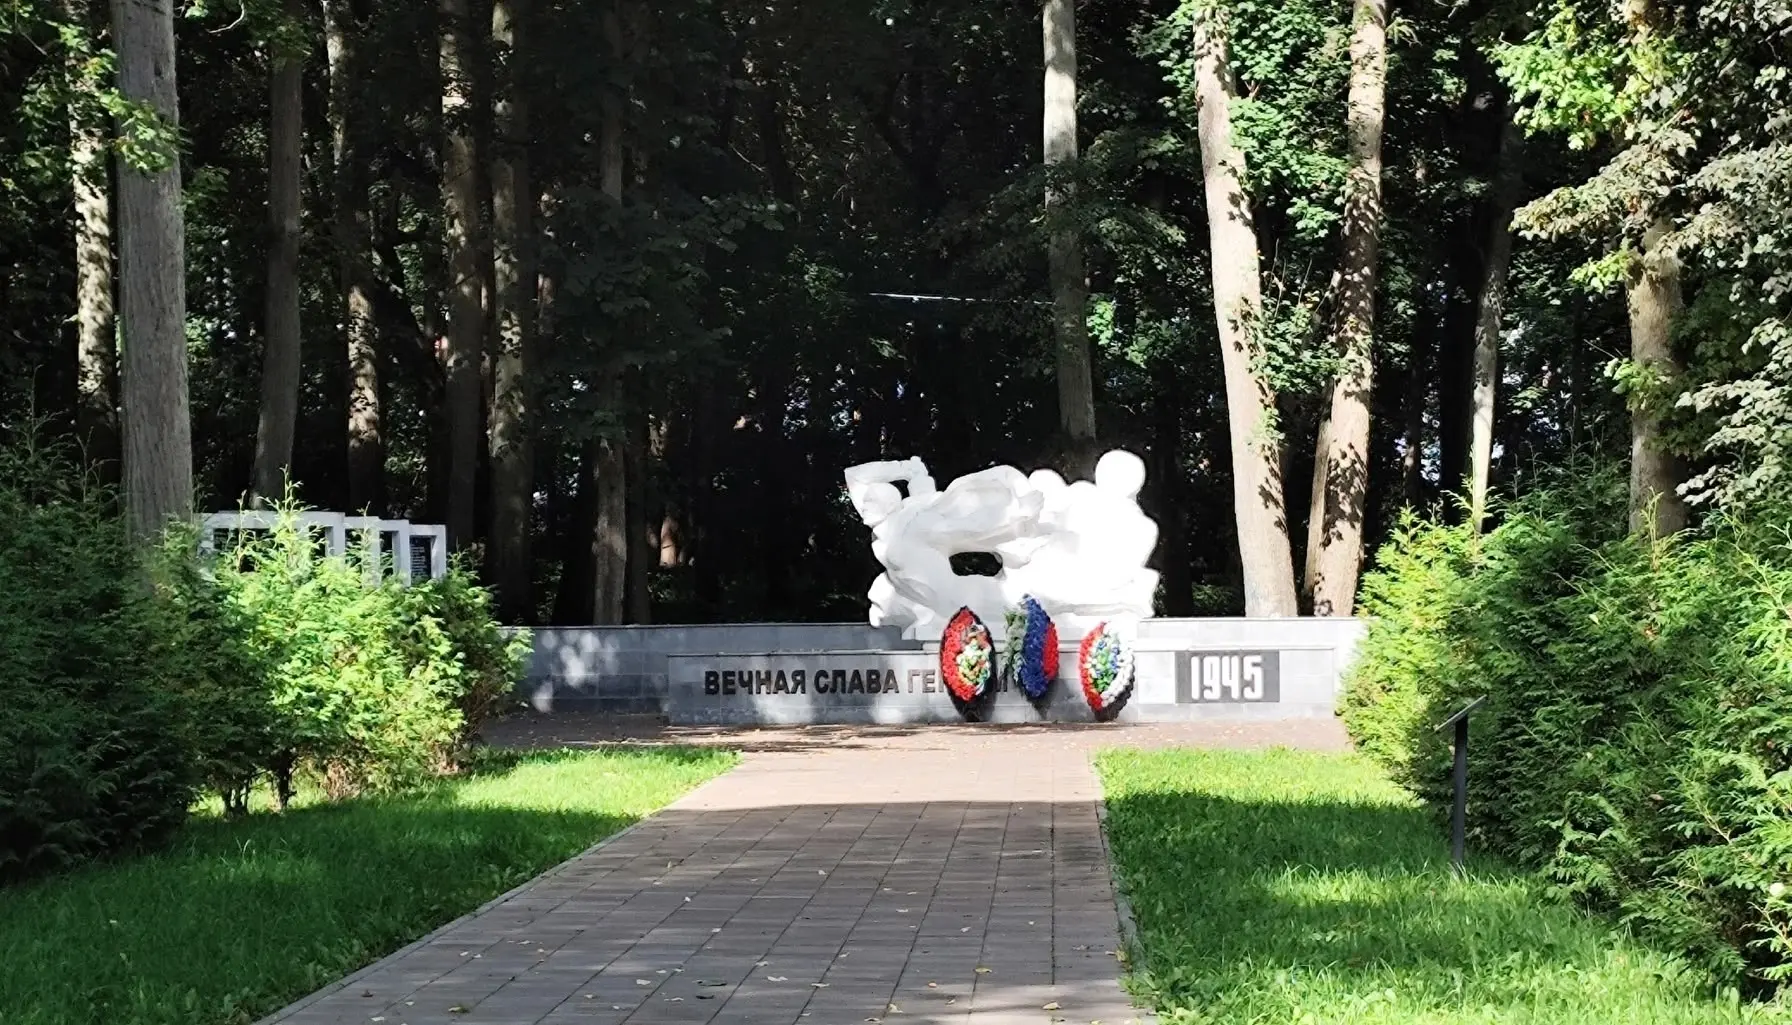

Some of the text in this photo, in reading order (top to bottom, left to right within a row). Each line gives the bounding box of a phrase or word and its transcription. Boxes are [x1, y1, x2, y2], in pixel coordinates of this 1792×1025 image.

[705, 669, 806, 695] ВЕЧНАЯ
[814, 669, 900, 694] СЛАВА
[1190, 655, 1264, 700] 1945
